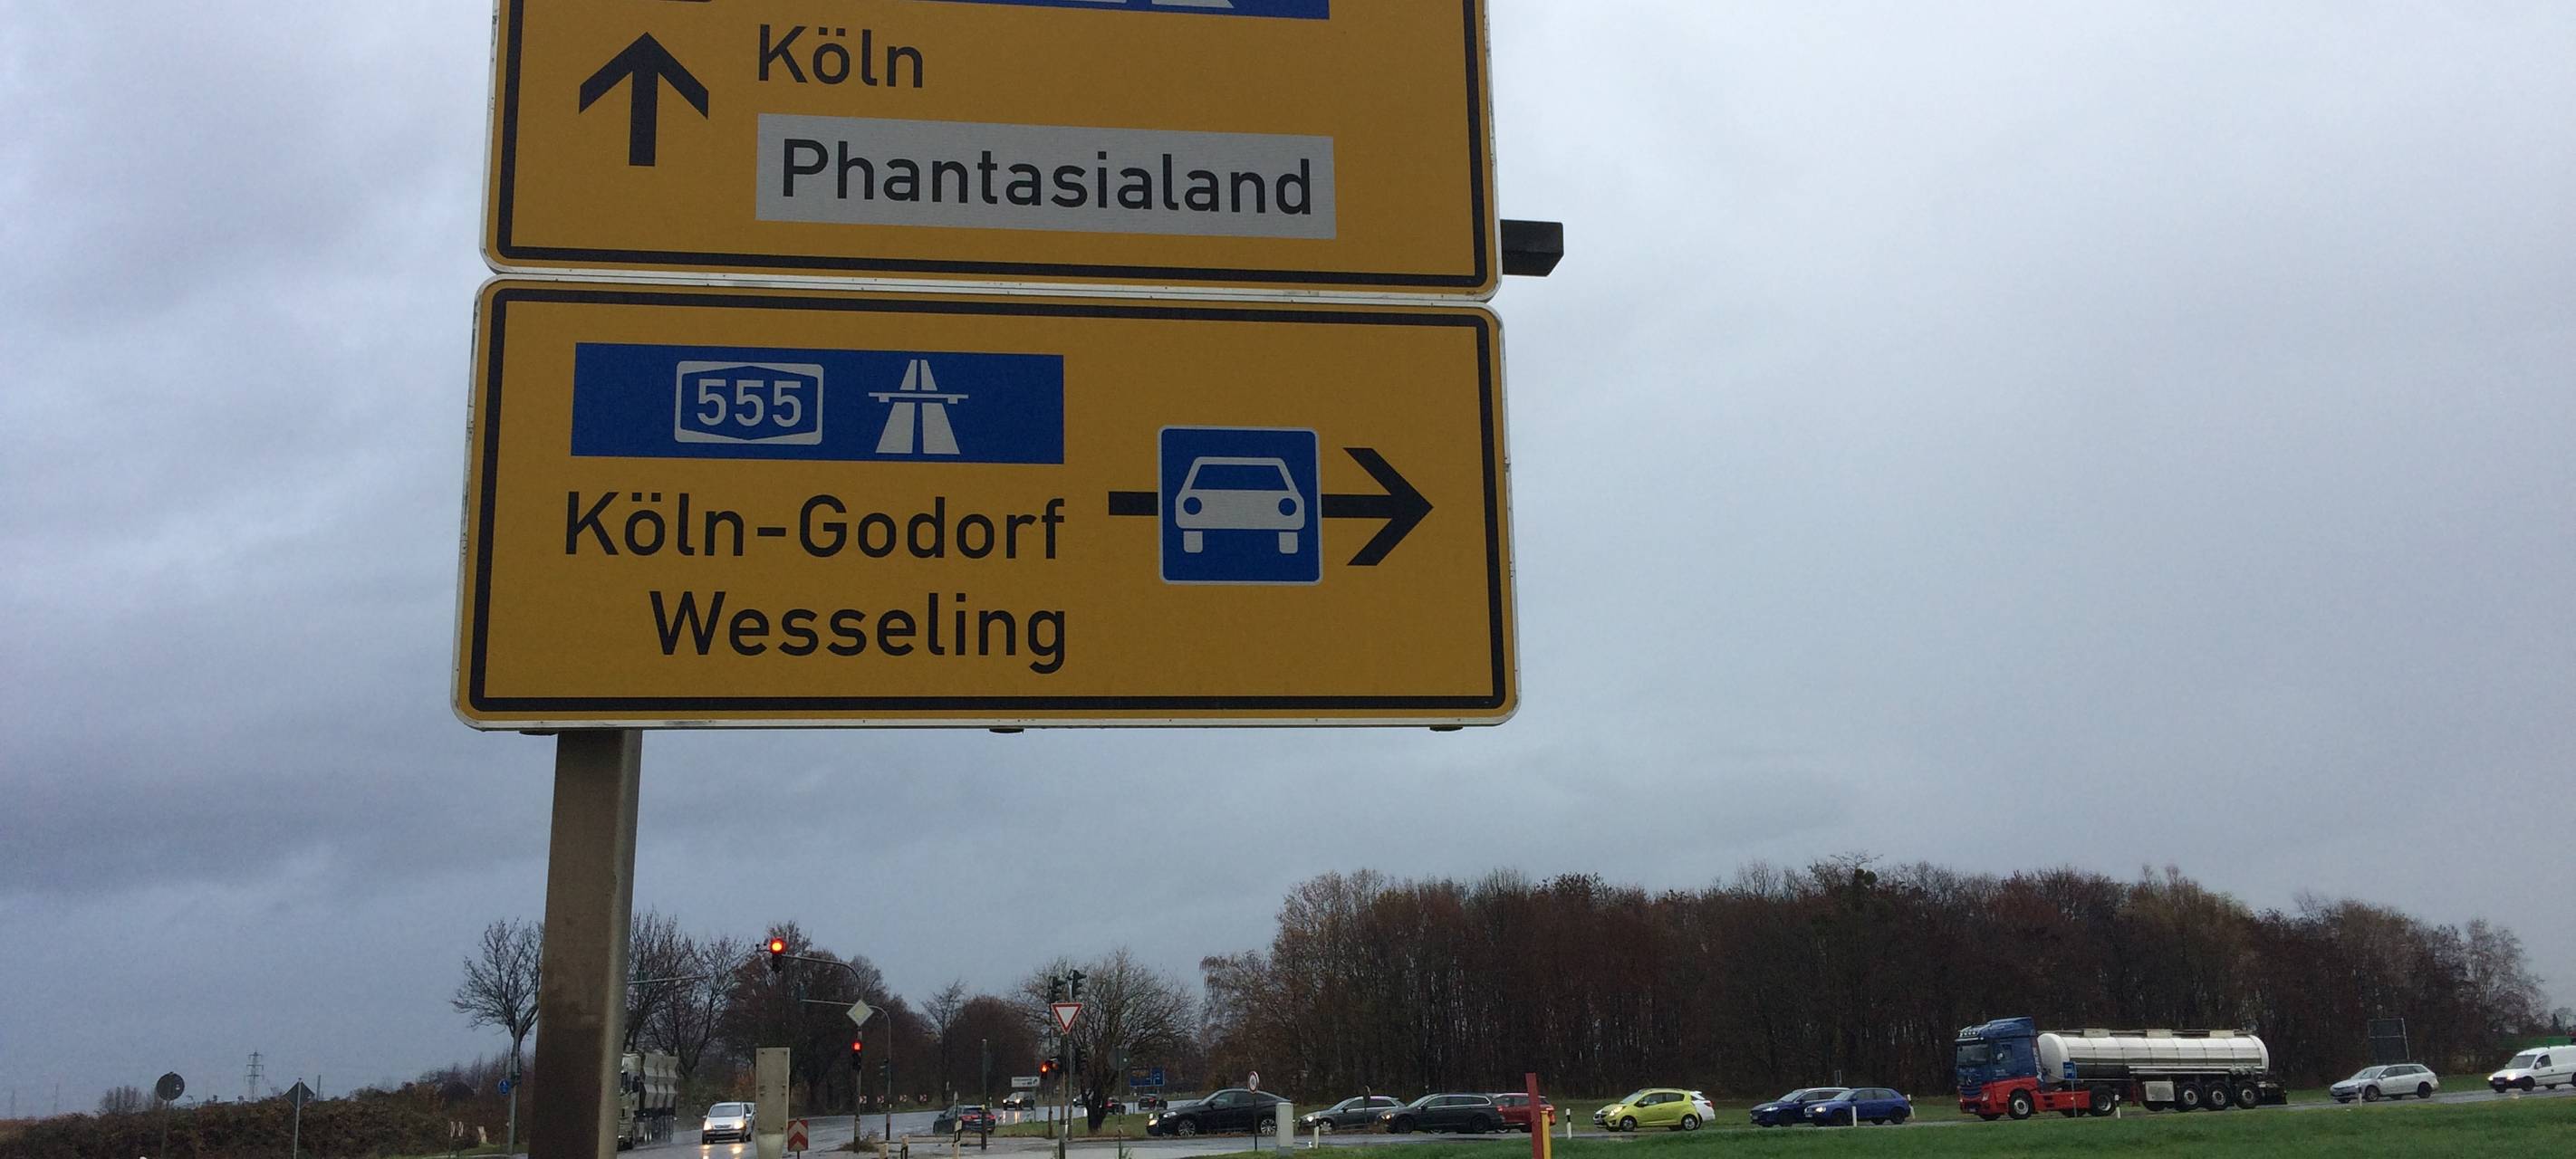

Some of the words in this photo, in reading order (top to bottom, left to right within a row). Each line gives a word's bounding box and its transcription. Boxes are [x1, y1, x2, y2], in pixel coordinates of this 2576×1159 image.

[758, 24, 923, 90] Köln
[783, 138, 1312, 216] Phantasialand
[697, 378, 803, 427] 555
[565, 491, 1065, 560] Köln-Godorf
[649, 590, 1065, 675] Wesseling
